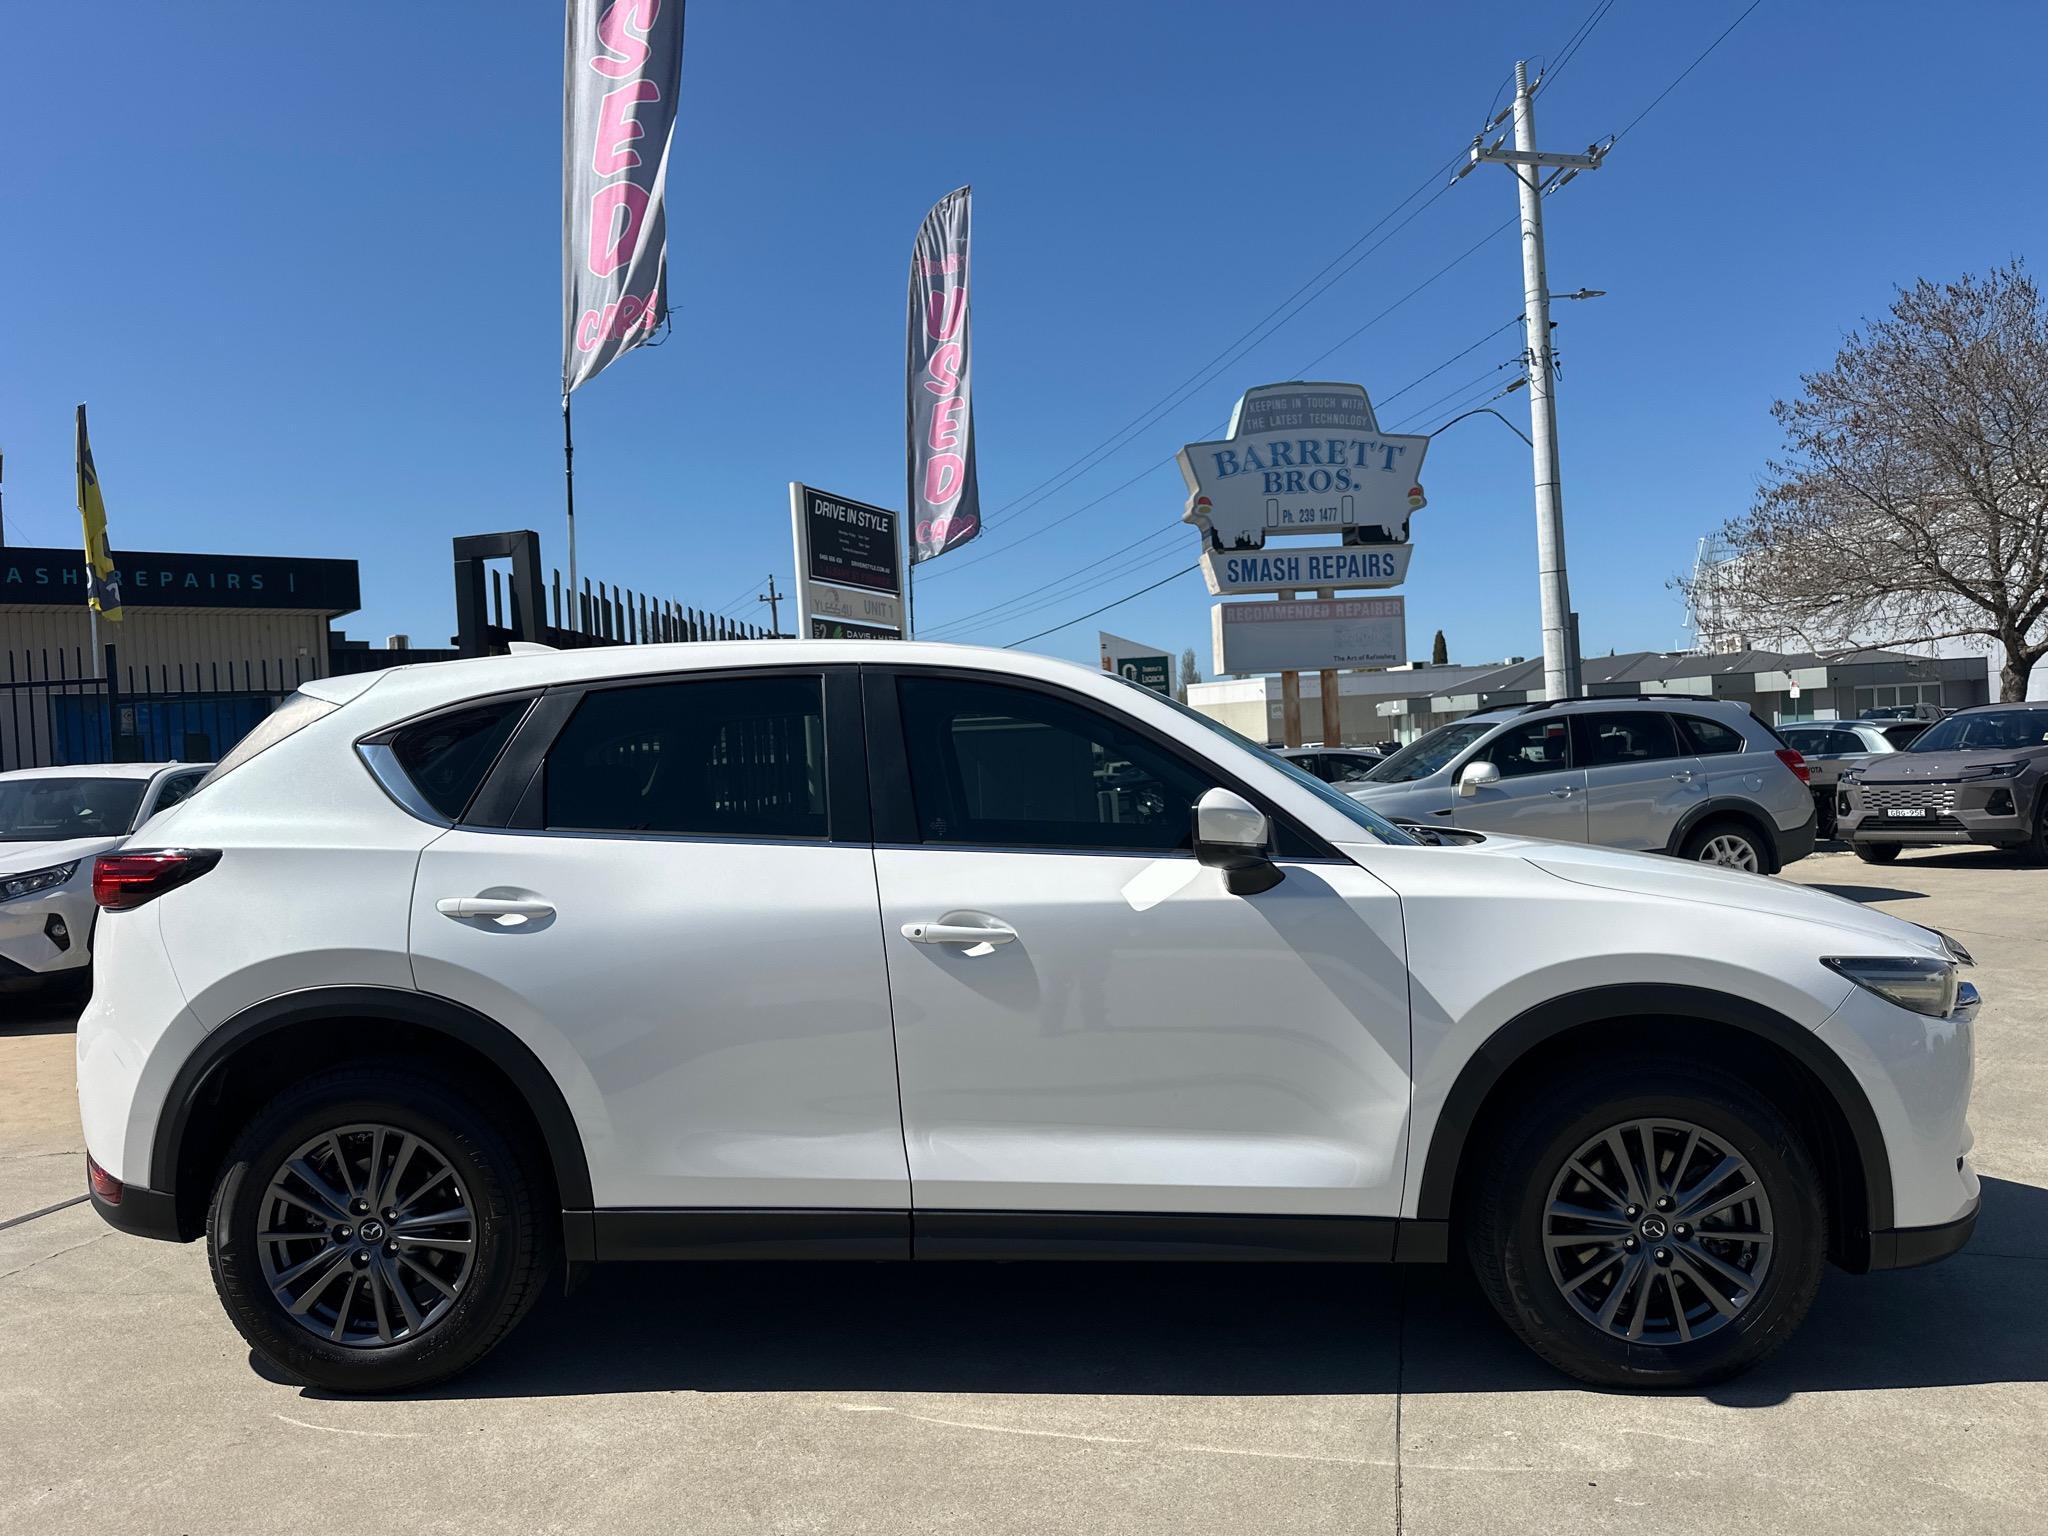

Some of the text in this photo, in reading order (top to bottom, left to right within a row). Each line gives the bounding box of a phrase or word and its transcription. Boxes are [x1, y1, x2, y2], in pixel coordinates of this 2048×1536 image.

[923, 287, 967, 505] USED
[1249, 398, 1364, 413] KEEPING IN TOUCH WITH
[1247, 413, 1368, 430] THE LATEST TECHNOLOGY
[1211, 439, 1406, 480] BARRETT
[1262, 467, 1361, 496] BROS.
[815, 499, 889, 532] DRIVE IN STYLE
[1299, 508, 1315, 522] 239
[1319, 507, 1338, 522] 1477
[6, 567, 78, 584] ASH
[113, 570, 264, 589] REPAIRS
[1227, 553, 1394, 583] SMASH REPAIRS
[864, 599, 894, 619] UNIT 1
[1226, 601, 1401, 622] RECOMMENDED REPAIRER
[847, 630, 871, 640] DAVIS
